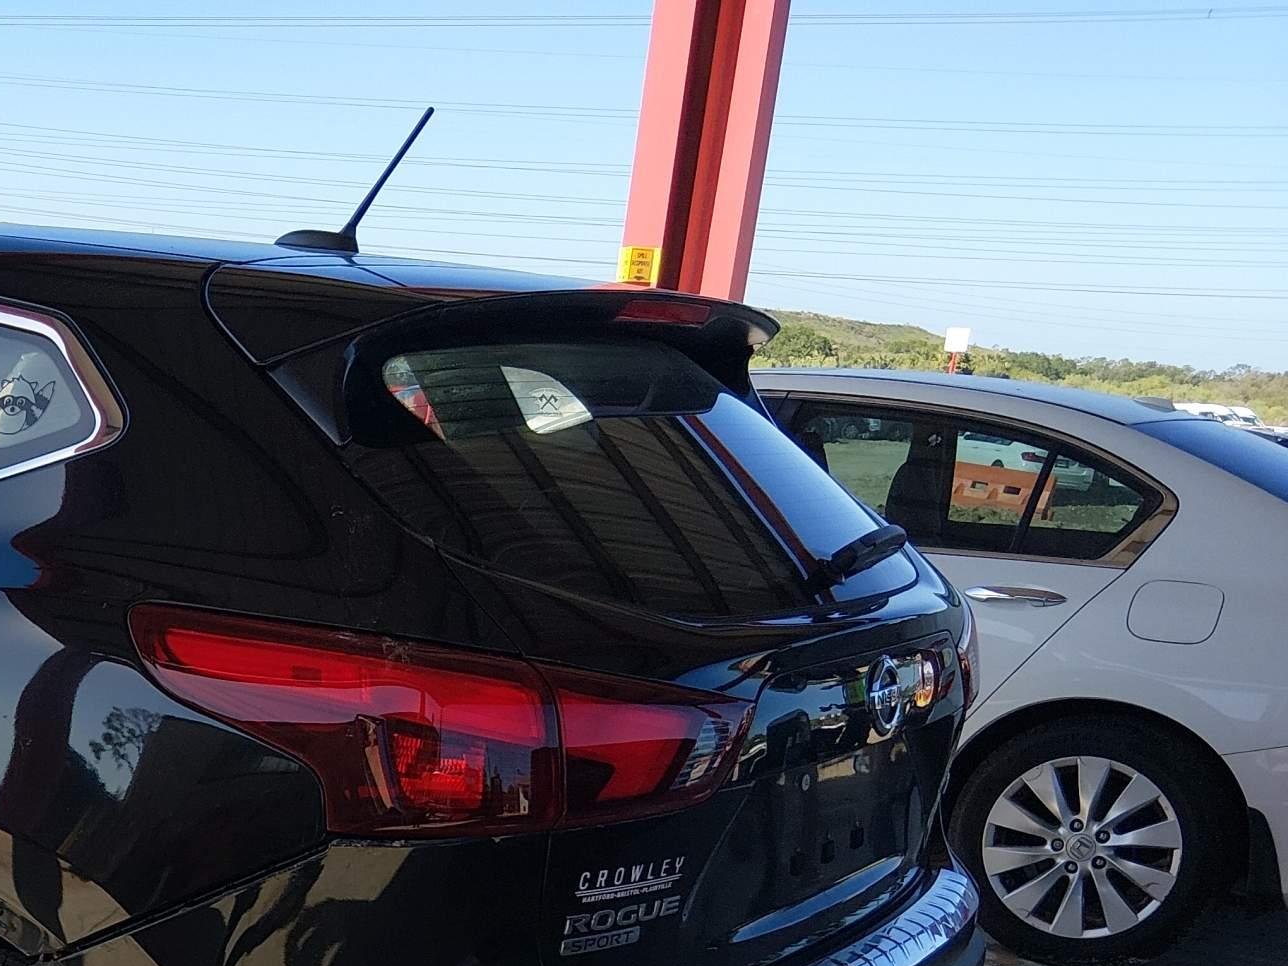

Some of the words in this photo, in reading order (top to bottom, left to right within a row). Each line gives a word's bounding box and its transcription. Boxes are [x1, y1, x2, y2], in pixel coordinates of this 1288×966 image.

[579, 856, 685, 890] CROWLEY
[564, 896, 680, 935] ROGUE
[571, 931, 632, 952] SPORT
